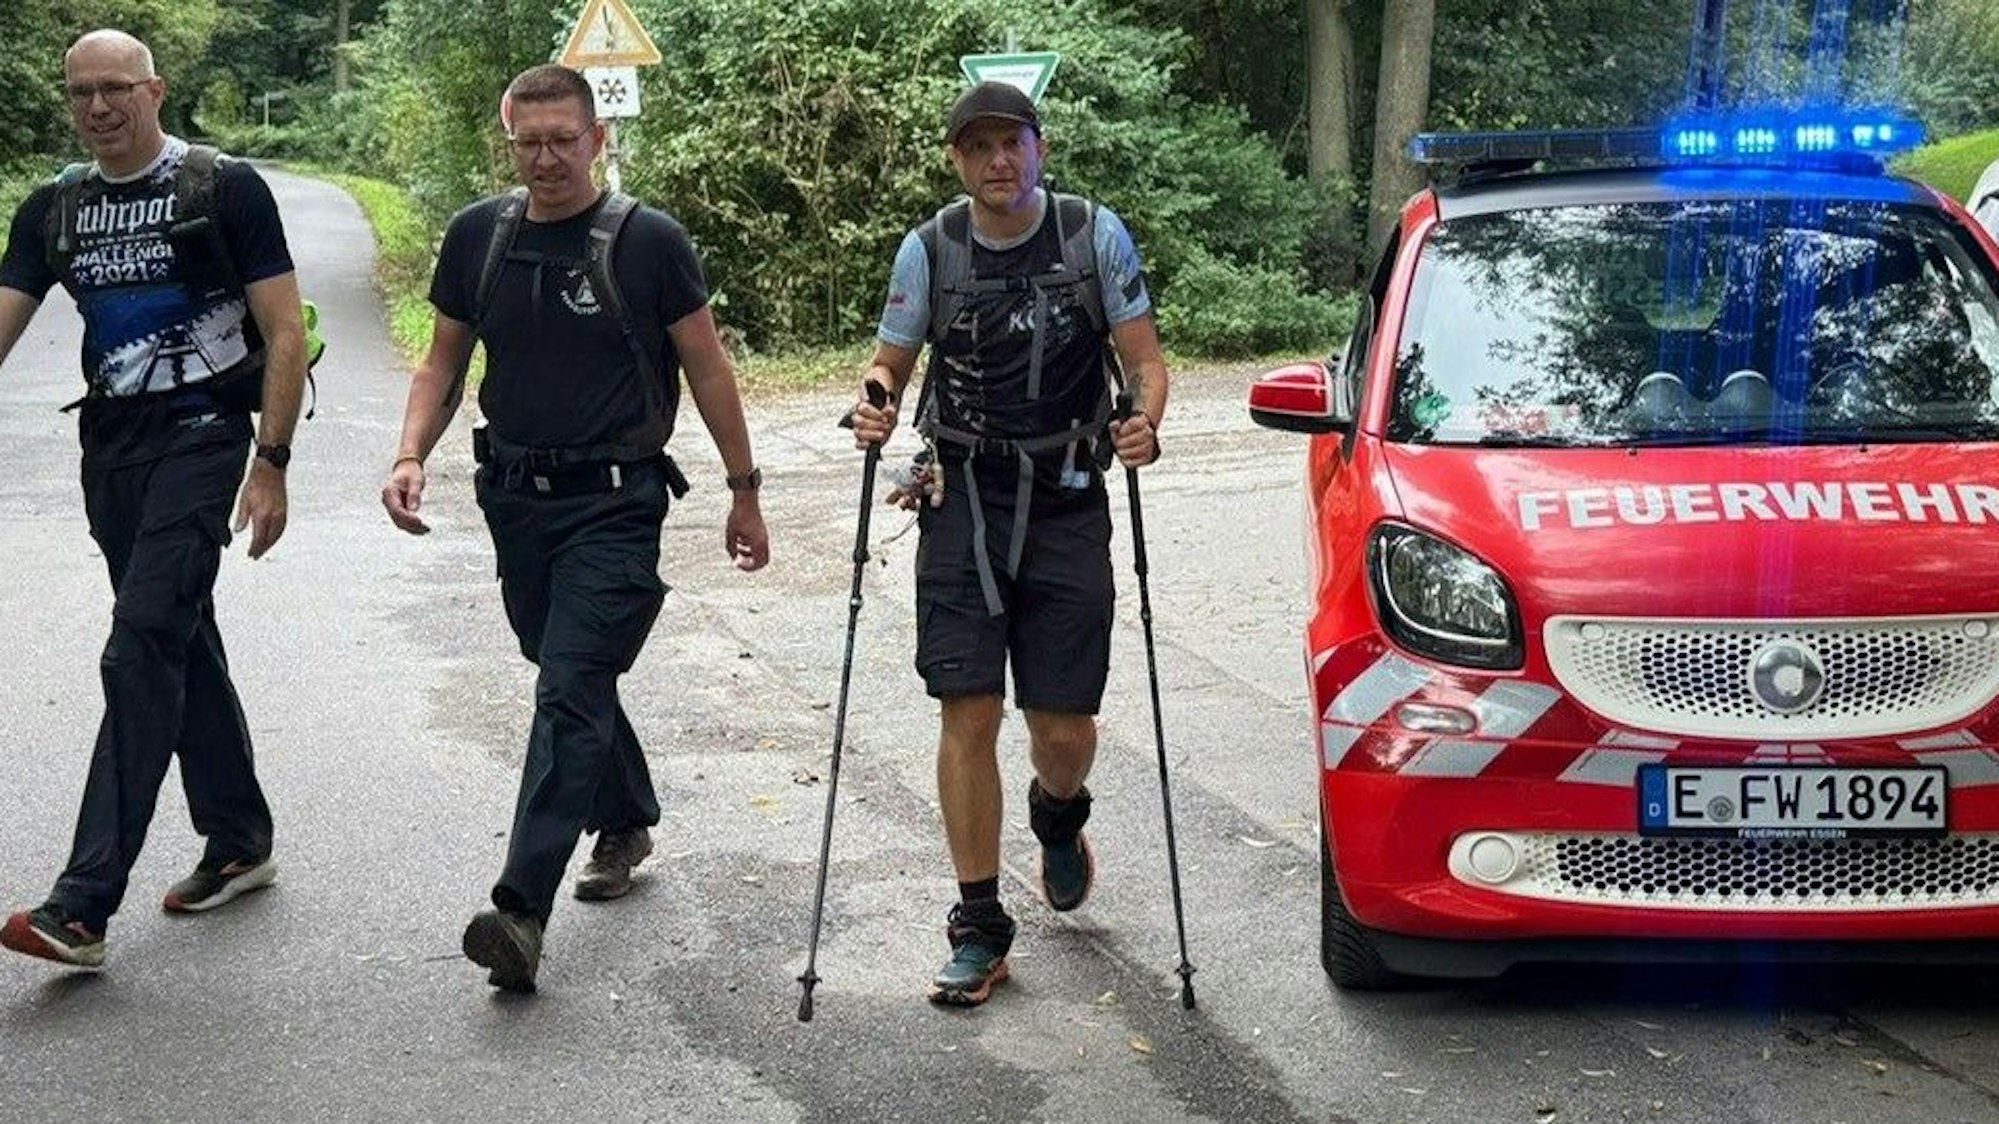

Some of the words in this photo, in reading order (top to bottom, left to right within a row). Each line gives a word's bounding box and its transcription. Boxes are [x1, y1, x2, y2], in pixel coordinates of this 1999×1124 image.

[75, 191, 178, 235] uhrpot
[69, 243, 175, 269] HALLENG
[90, 261, 149, 286] 2021
[1518, 481, 1999, 532] FEUERWEHR
[1649, 802, 1661, 817] D
[1674, 775, 1704, 820] E
[1740, 775, 1803, 820] FW
[1816, 775, 1939, 821] 1894
[1738, 828, 1810, 839] FEUERWEHR
[1811, 828, 1847, 839] ESSEN
